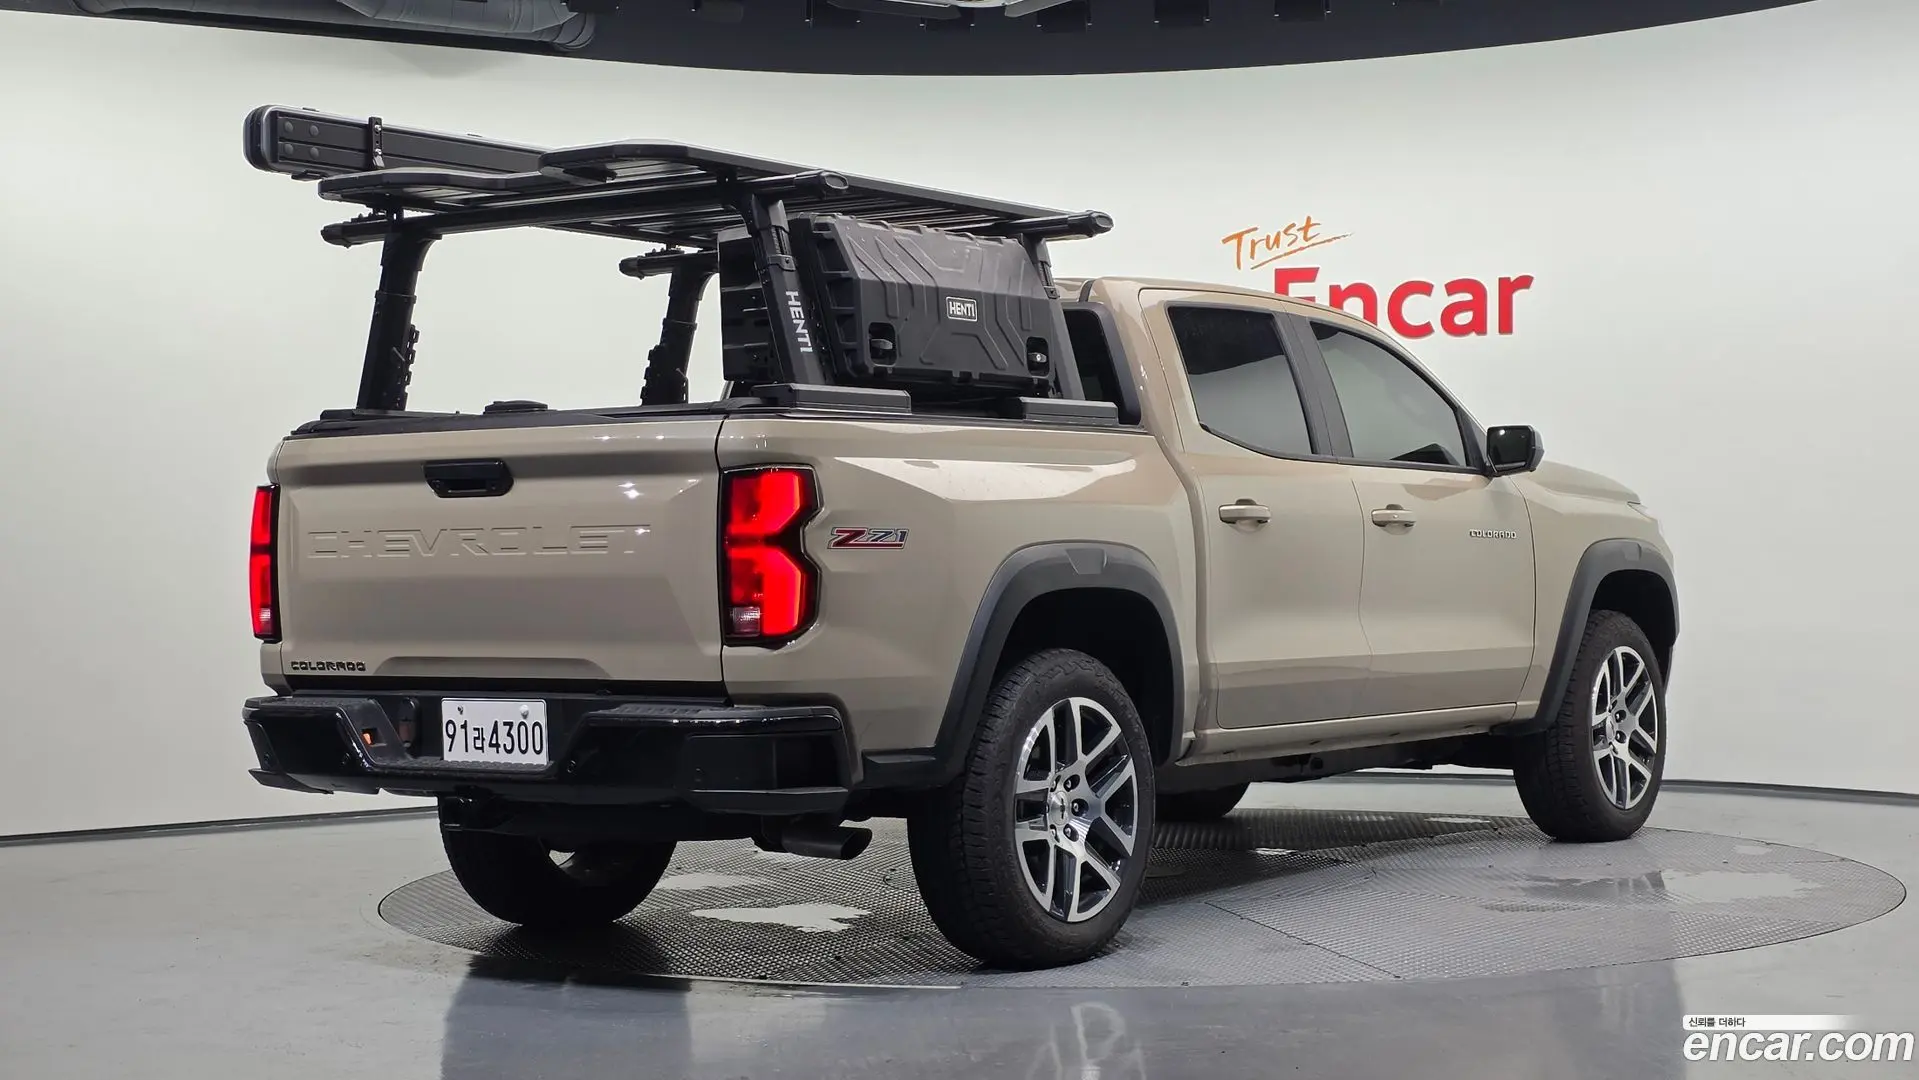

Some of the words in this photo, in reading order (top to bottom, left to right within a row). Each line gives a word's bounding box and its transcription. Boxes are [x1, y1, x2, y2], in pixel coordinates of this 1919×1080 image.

[1222, 216, 1322, 269] Trust
[785, 291, 813, 353] HENTI
[949, 301, 976, 317] HENTI
[307, 524, 651, 558] CHEVROLET
[827, 526, 909, 550] Z71
[1469, 529, 1517, 539] COLORADO
[291, 661, 366, 671] COLORADO
[445, 719, 544, 755] 91라4300
